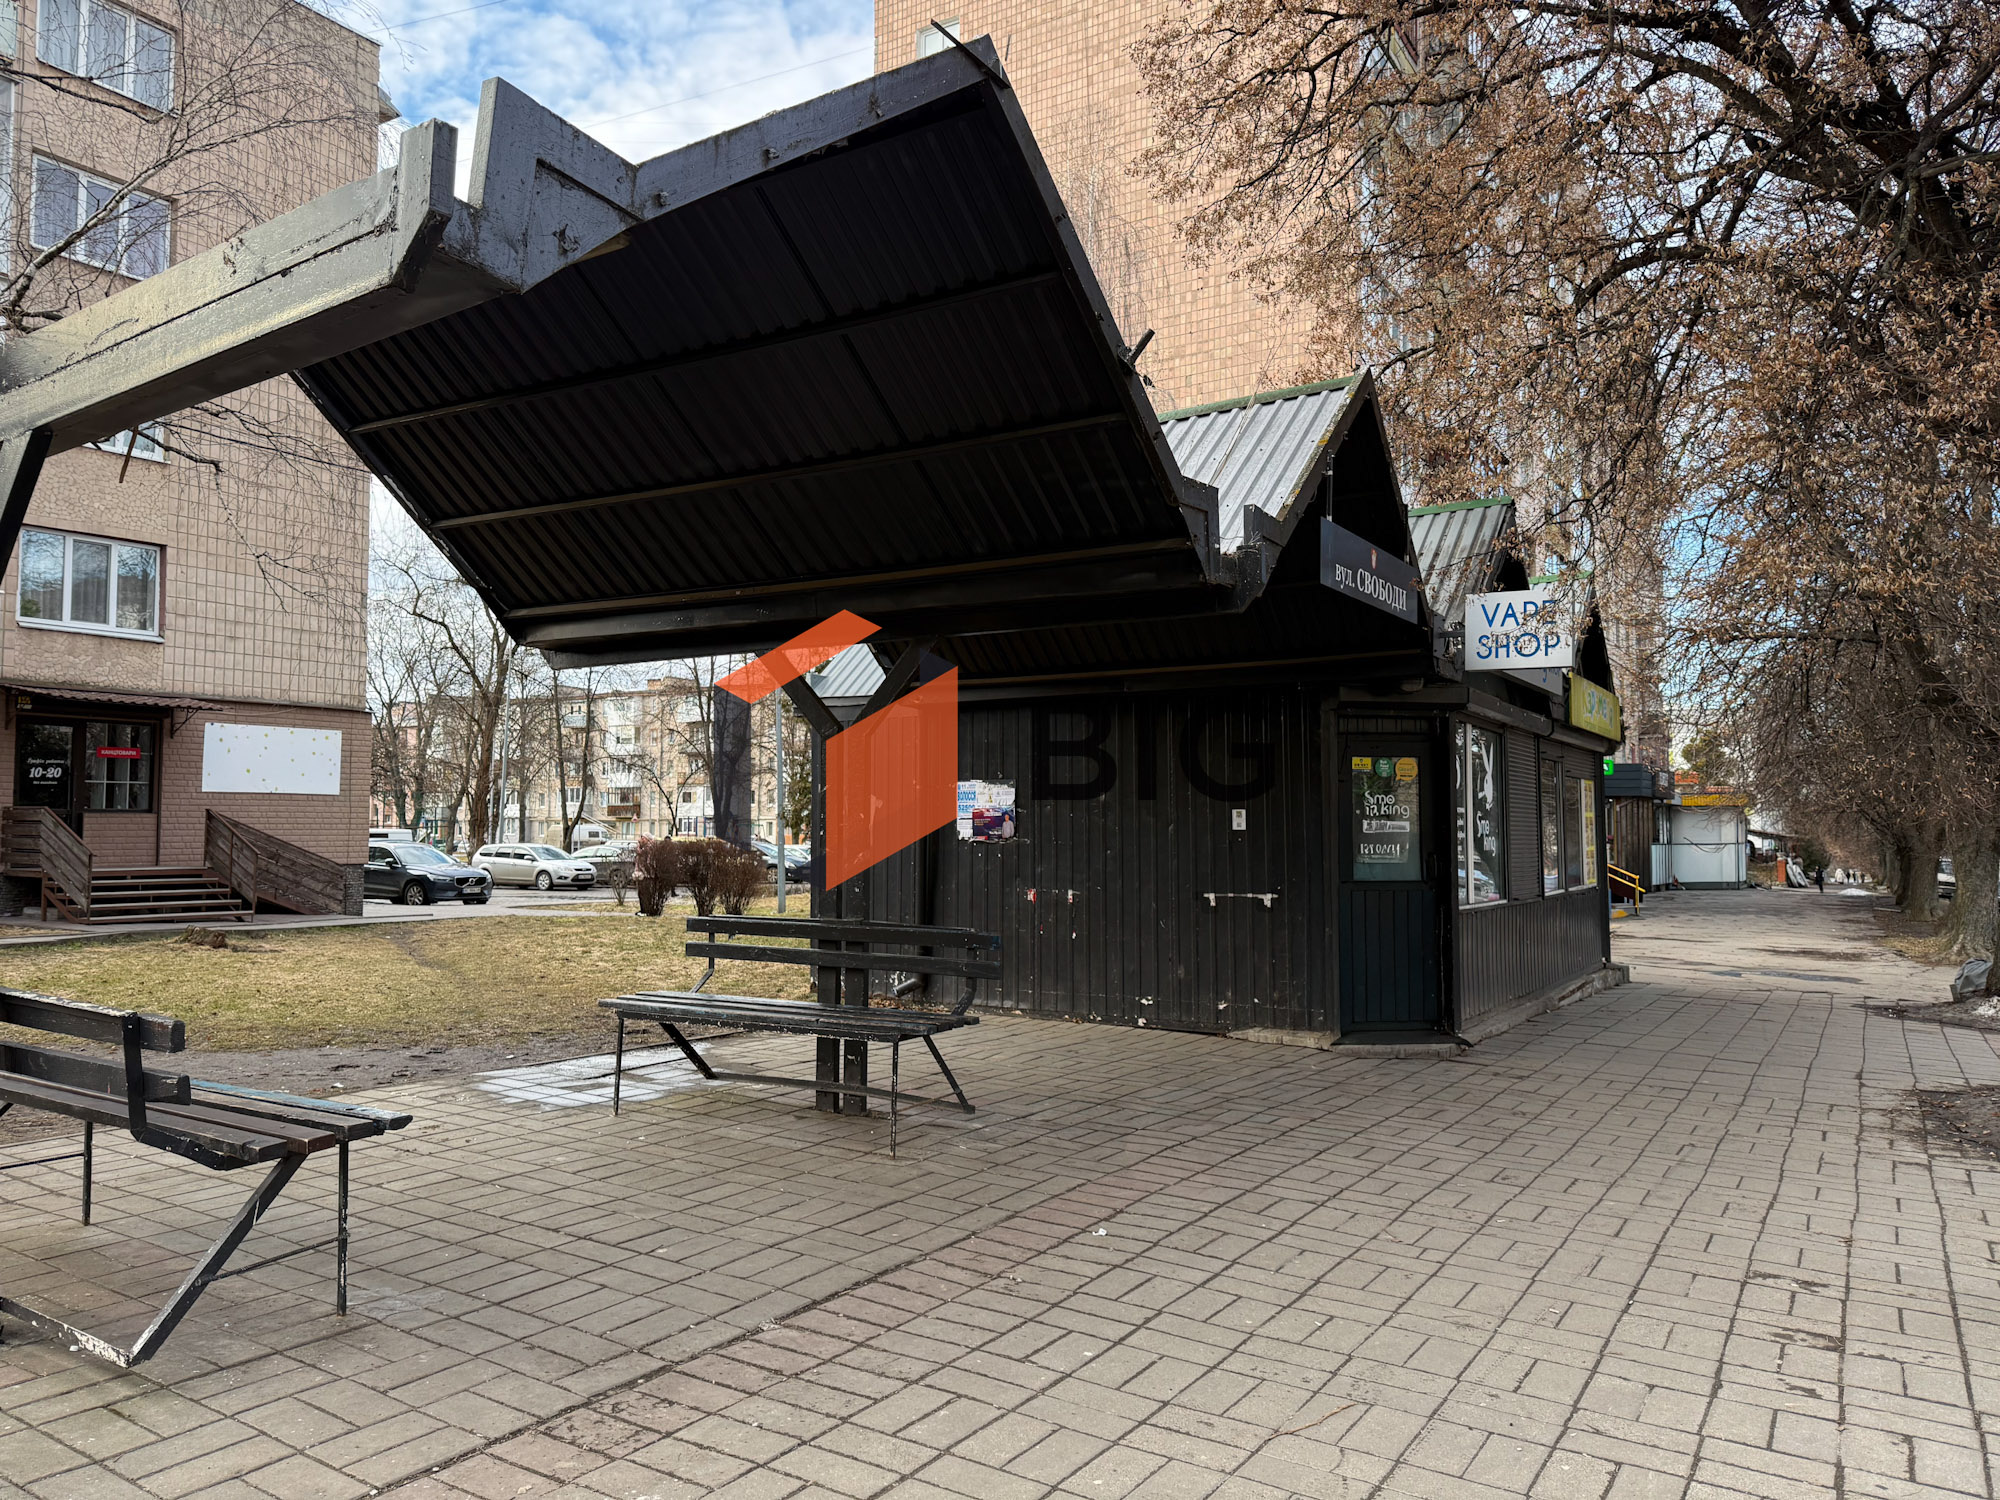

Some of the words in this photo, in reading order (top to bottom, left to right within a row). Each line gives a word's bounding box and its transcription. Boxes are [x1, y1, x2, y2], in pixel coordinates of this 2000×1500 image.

[1335, 563, 1355, 589] вул.
[1357, 568, 1407, 612] СВОБОДИ
[1476, 632, 1561, 660] SHOP
[29, 767, 62, 778] 10-20
[1364, 790, 1396, 805] Smo
[1380, 802, 1410, 819] king
